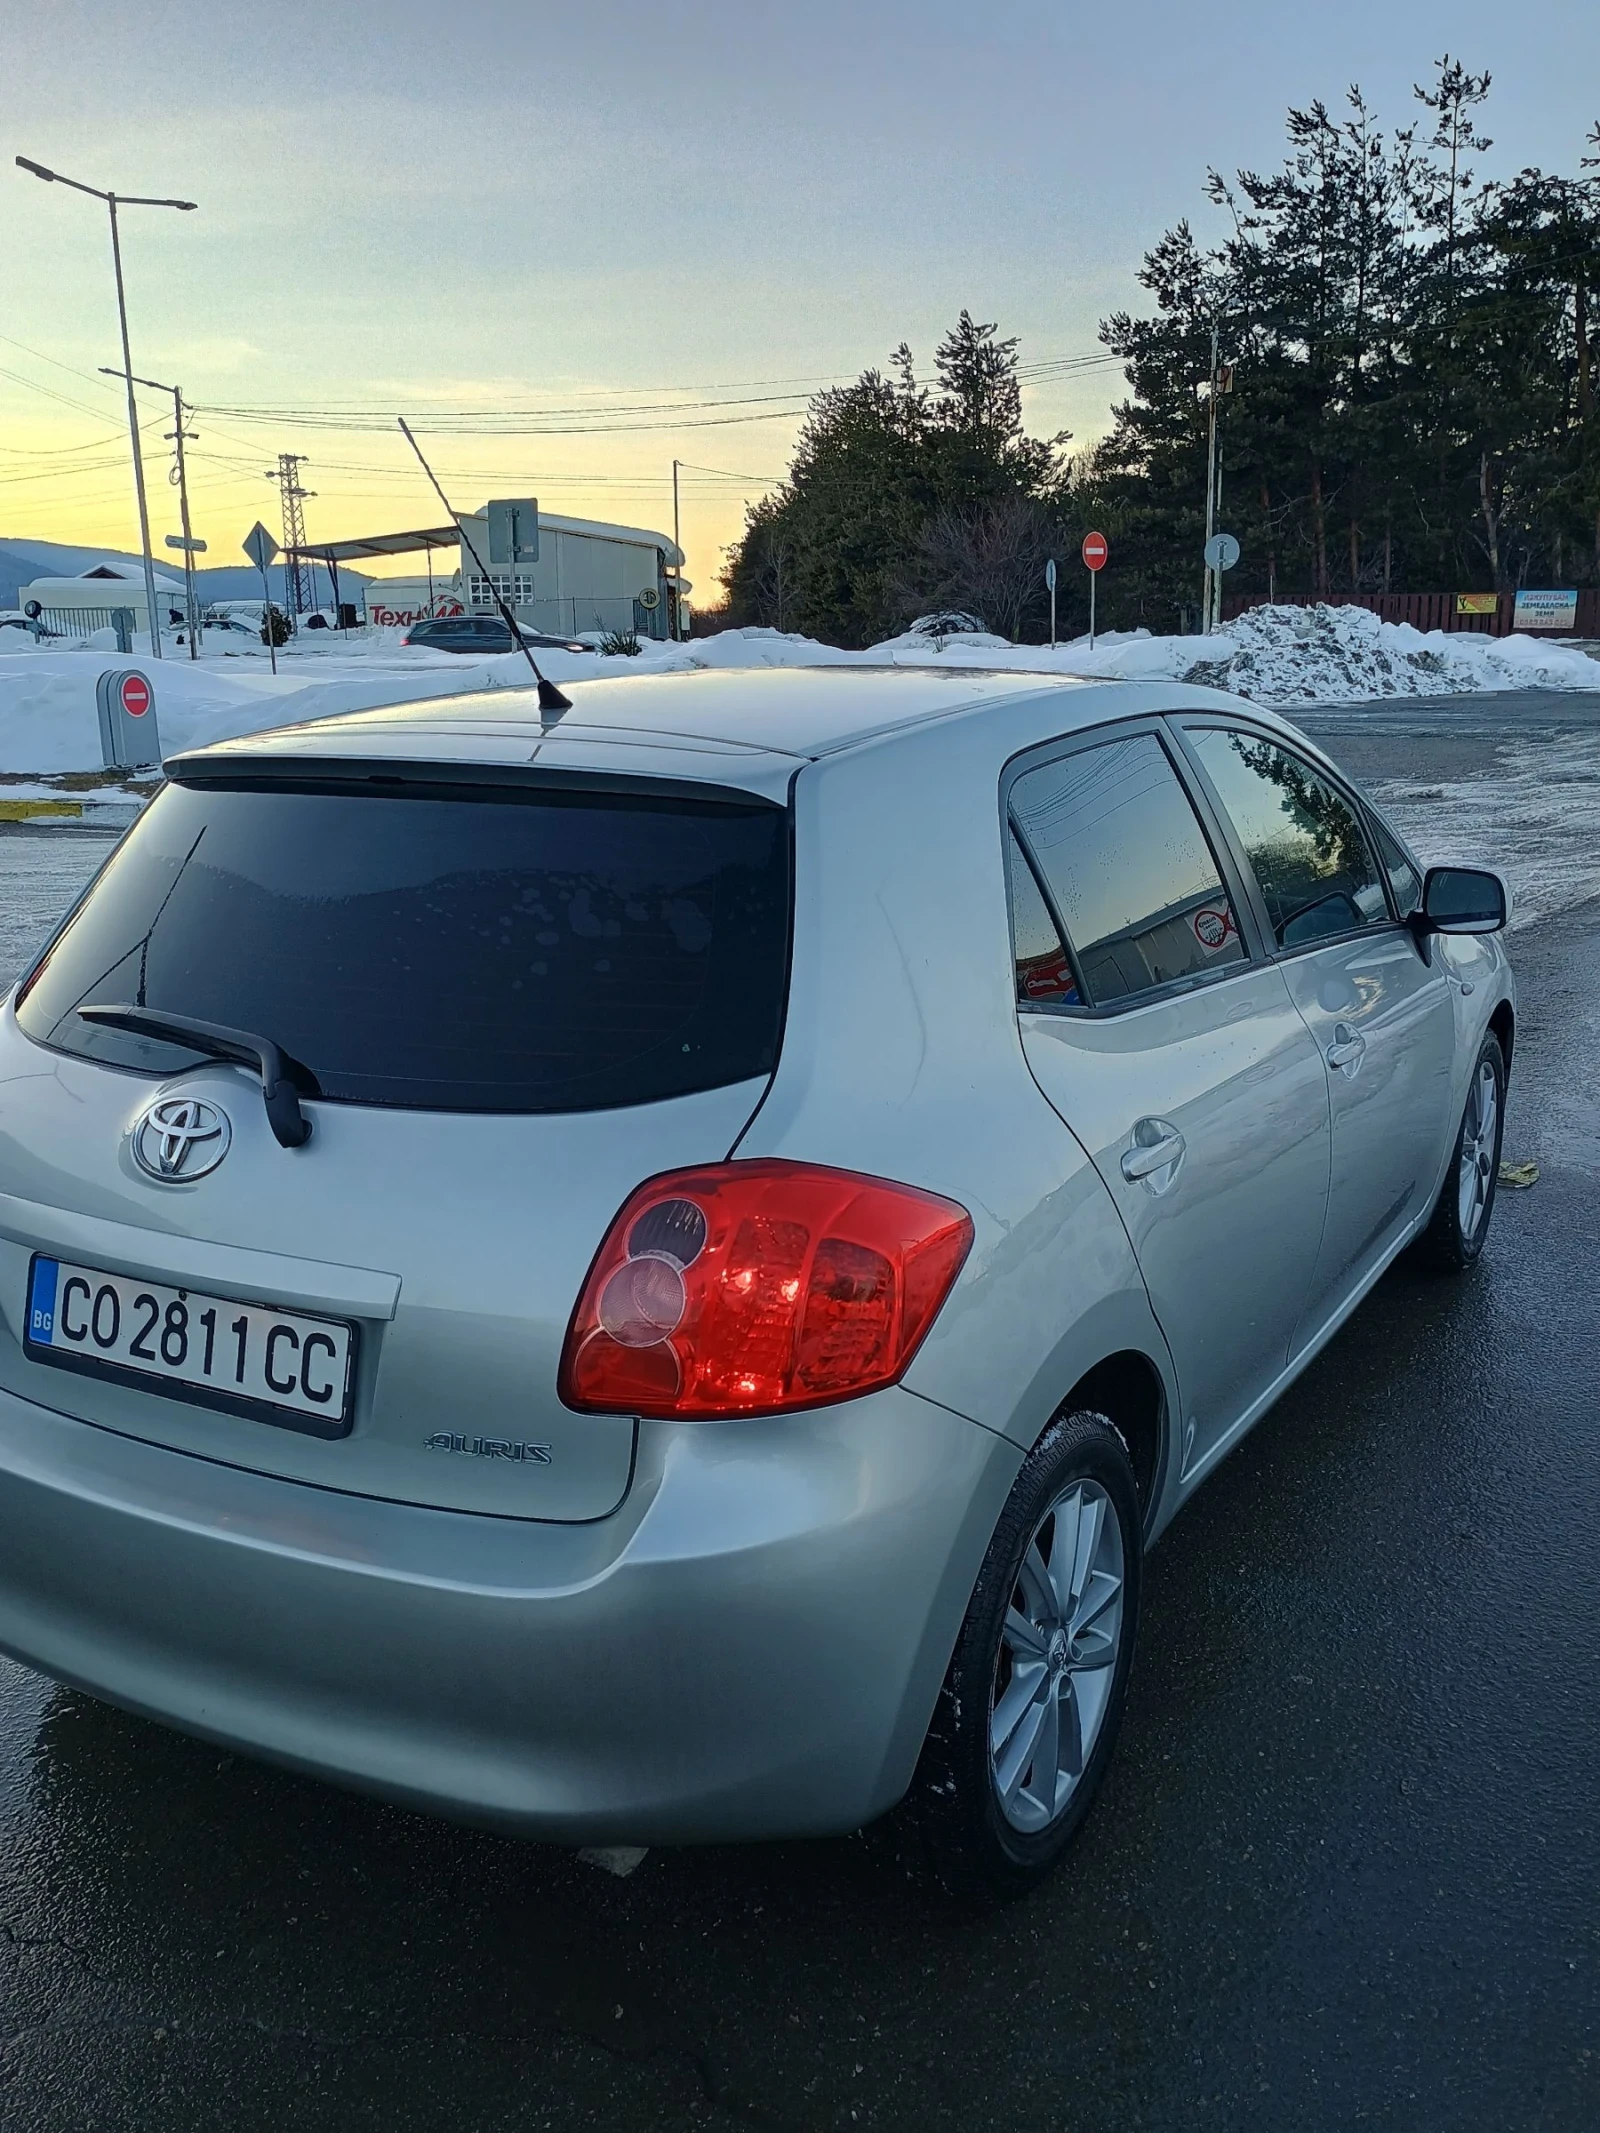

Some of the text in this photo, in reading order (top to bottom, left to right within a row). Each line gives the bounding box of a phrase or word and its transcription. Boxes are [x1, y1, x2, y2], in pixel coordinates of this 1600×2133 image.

[33, 1309, 52, 1331] BG
[129, 1293, 249, 1384] 2811
[264, 1324, 337, 1403] CC
[423, 1430, 553, 1465] AURIS
